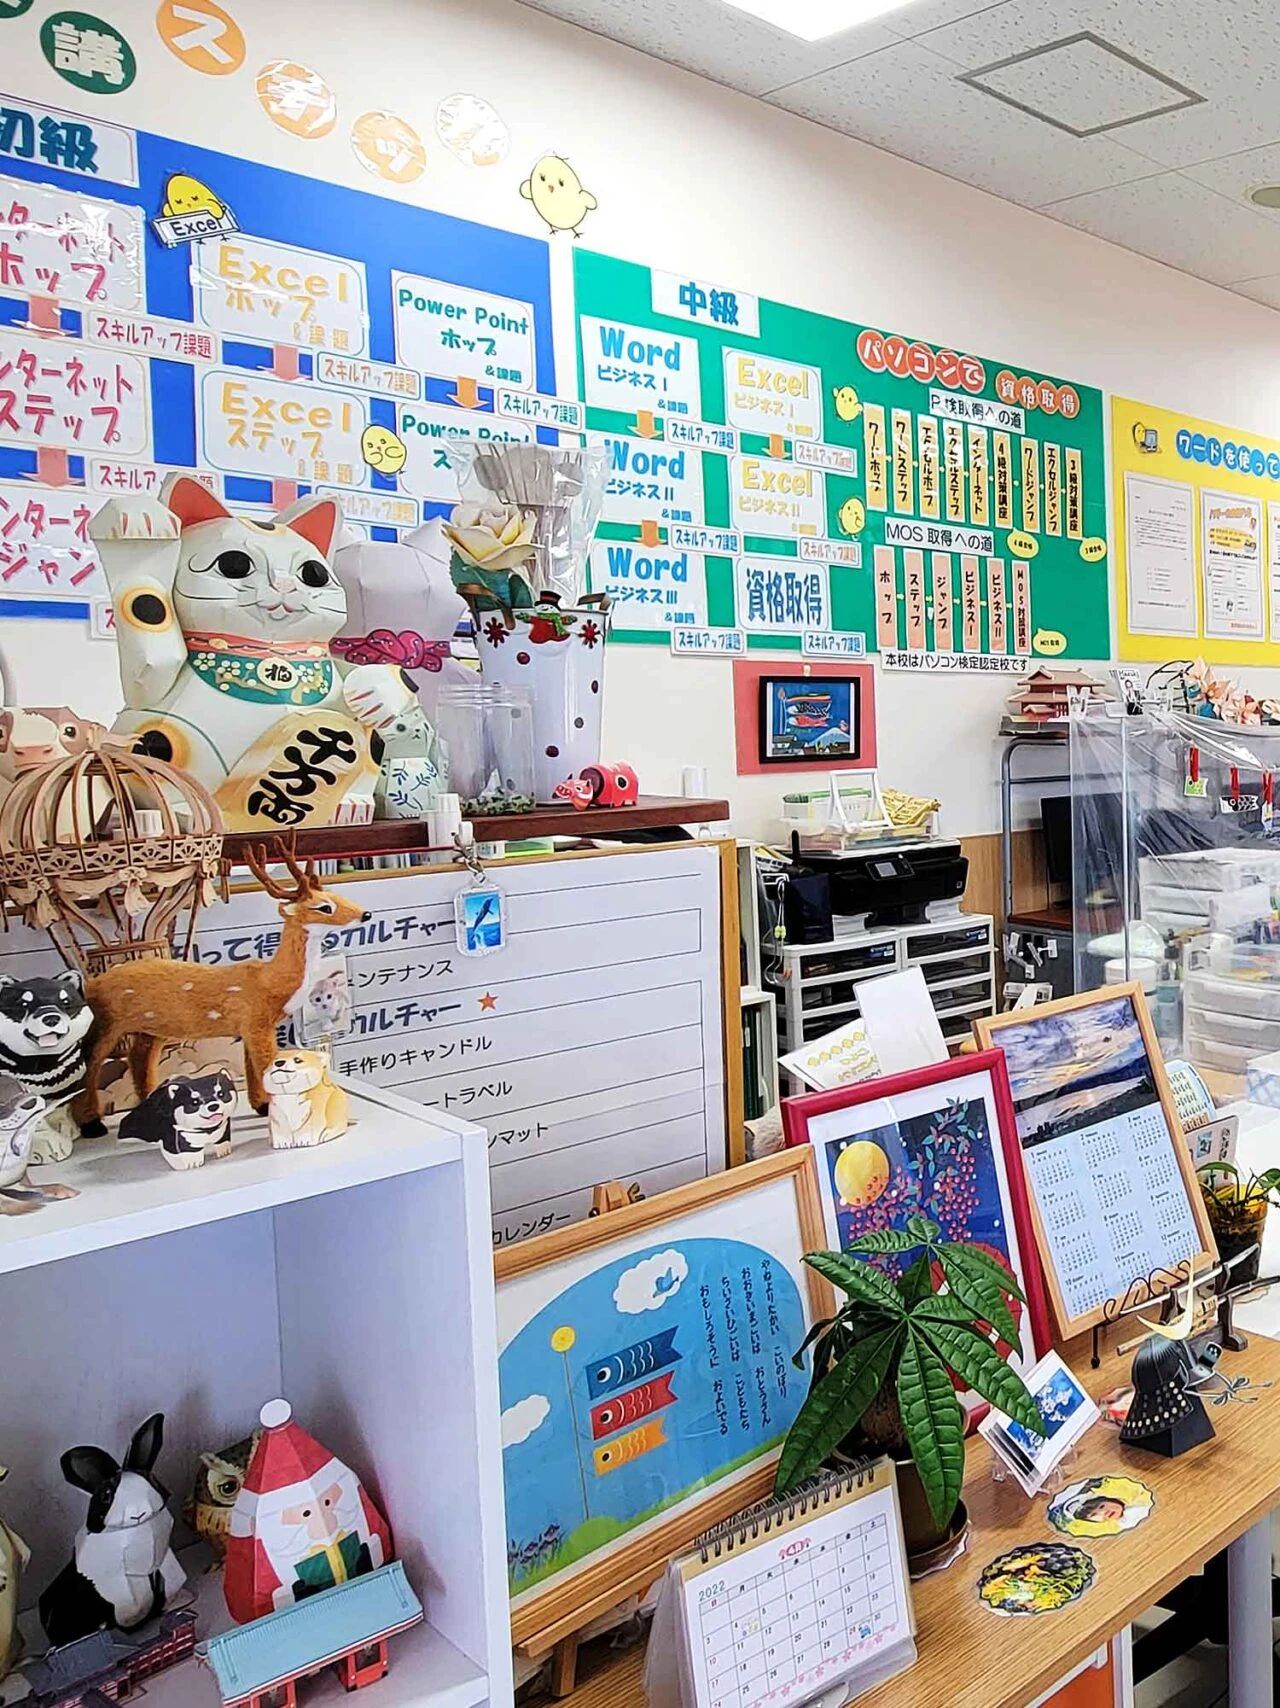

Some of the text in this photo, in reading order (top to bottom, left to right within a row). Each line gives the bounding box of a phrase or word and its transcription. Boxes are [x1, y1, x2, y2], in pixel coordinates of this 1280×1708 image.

[170, 214, 225, 237] Excel
[218, 244, 348, 302] Excel
[399, 289, 529, 335] Power Point
[679, 281, 739, 326] 中級
[97, 318, 212, 359] スキルアップ課題
[440, 328, 497, 356] ホップ
[599, 325, 681, 372] Word
[737, 356, 809, 399] Excel
[864, 337, 1074, 414] パソコンで 資格取得
[221, 382, 352, 433] Excel
[503, 394, 578, 426] スキルアップ課題
[226, 418, 324, 460] ステップ
[671, 423, 735, 449] スキルアップ課題
[741, 460, 813, 498] Excel
[675, 529, 738, 551] スキルアップ課題
[607, 546, 688, 583] Word
[746, 568, 822, 626] 資格取得
[880, 570, 893, 625] ホップ
[910, 573, 921, 628] ステップ
[937, 576, 948, 630] ジャンプ
[677, 631, 741, 650] スキルアップ課題
[807, 633, 861, 653] スキルアップ課題
[885, 653, 1028, 672] 本校はパソコン検定認定校です
[339, 1035, 493, 1077] 手作りキャンドル
[699, 1284, 729, 1436] おもしろそうに およいでる
[774, 1345, 788, 1399] こいのぼり
[735, 1373, 750, 1432] こどもたち
[755, 1366, 772, 1428] おとうさん
[698, 1581, 726, 1601] 2022
